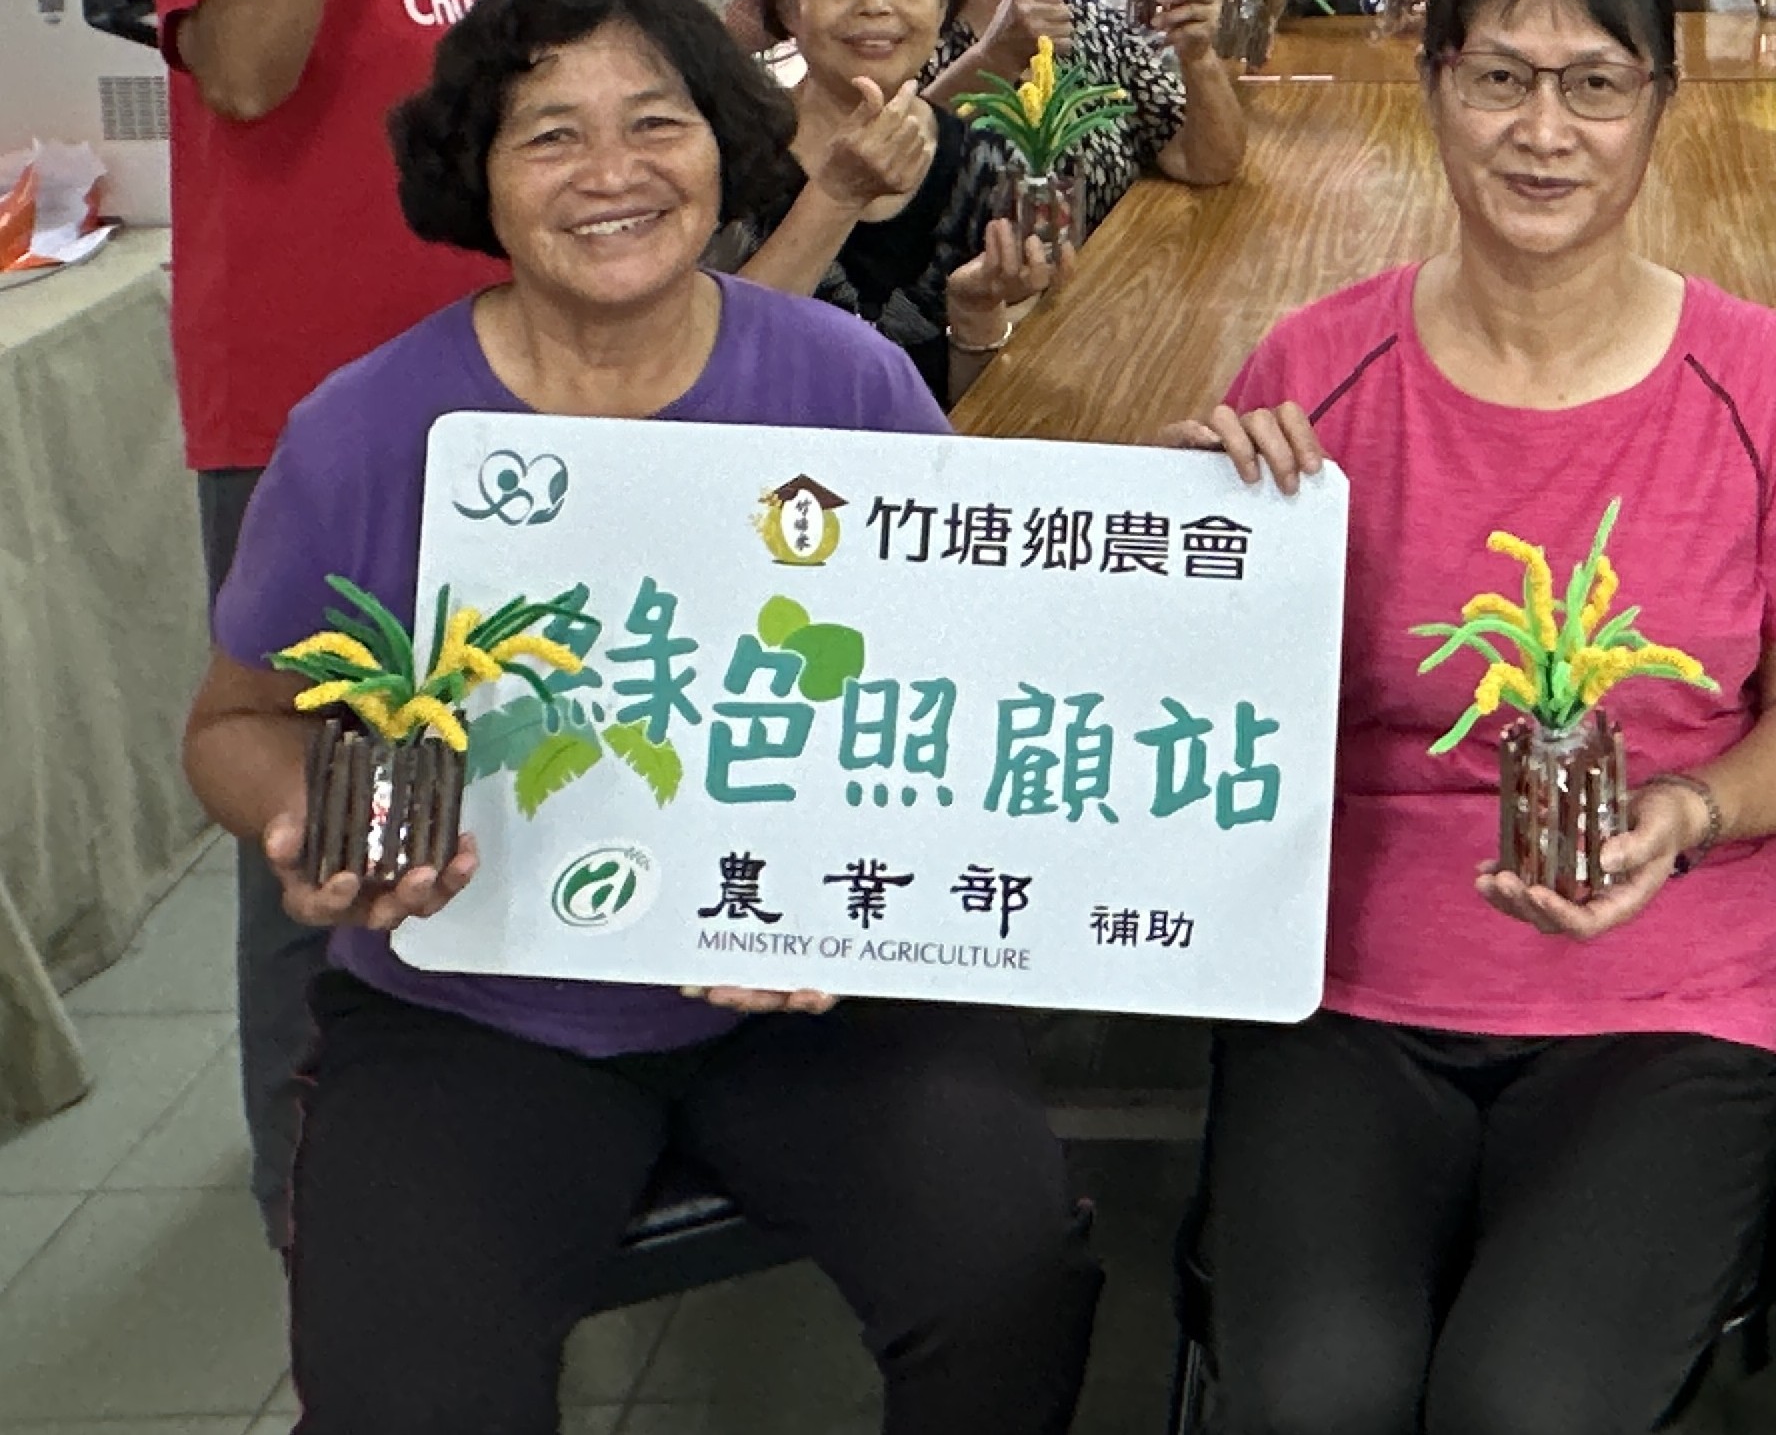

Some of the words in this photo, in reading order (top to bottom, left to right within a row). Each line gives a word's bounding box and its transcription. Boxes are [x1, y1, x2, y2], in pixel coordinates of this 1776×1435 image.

[867, 496, 1254, 581] 竹塘鄉農會
[540, 575, 1284, 831] 綠色照顧站
[697, 851, 1033, 939] 農業部
[1089, 905, 1196, 950] 補助
[697, 930, 814, 957] MINISTRY
[818, 937, 853, 960] OF
[859, 940, 1032, 971] AGRICULTURE
